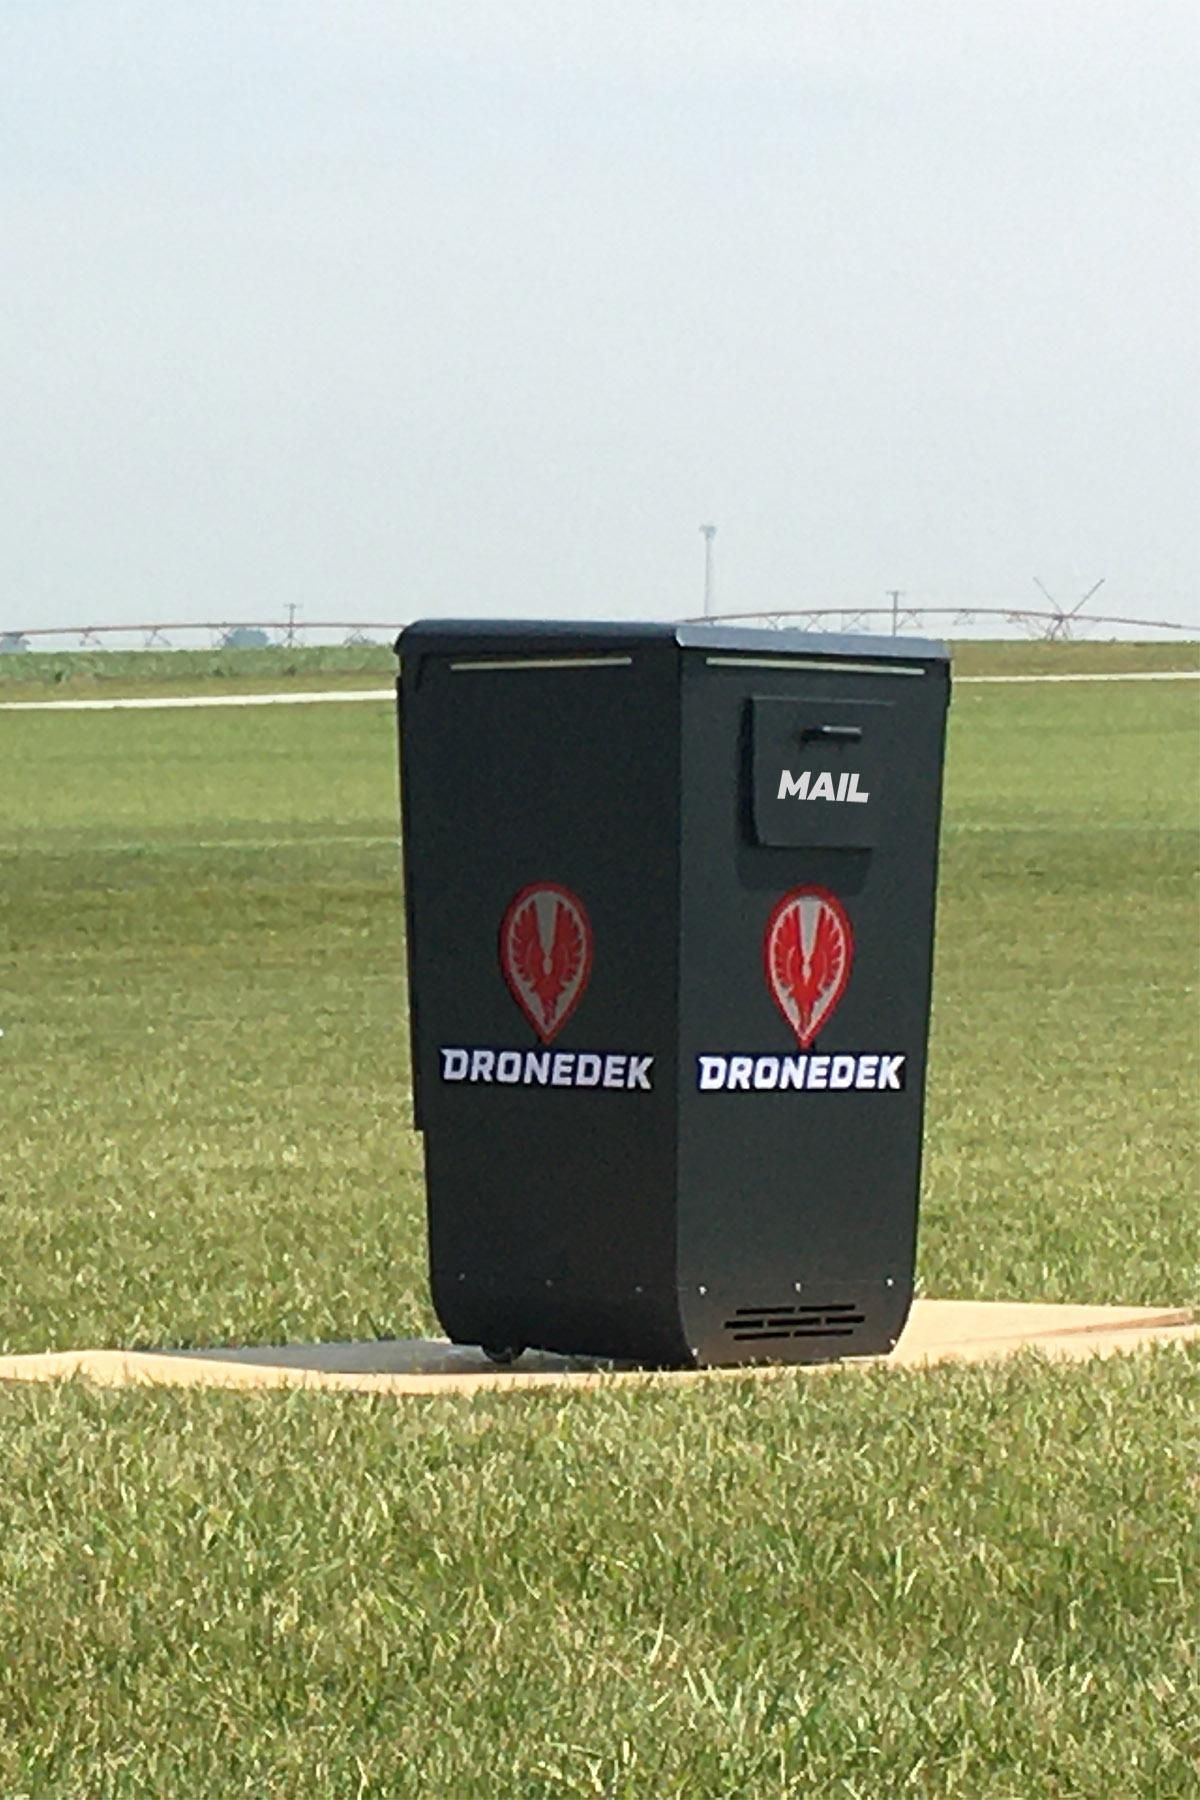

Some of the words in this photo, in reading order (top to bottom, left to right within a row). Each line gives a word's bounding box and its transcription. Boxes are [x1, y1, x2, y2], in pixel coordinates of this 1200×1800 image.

[777, 769, 869, 803] MAIL
[441, 1049, 654, 1090] DRONEDEK
[698, 1054, 905, 1090] DRONEDEK
